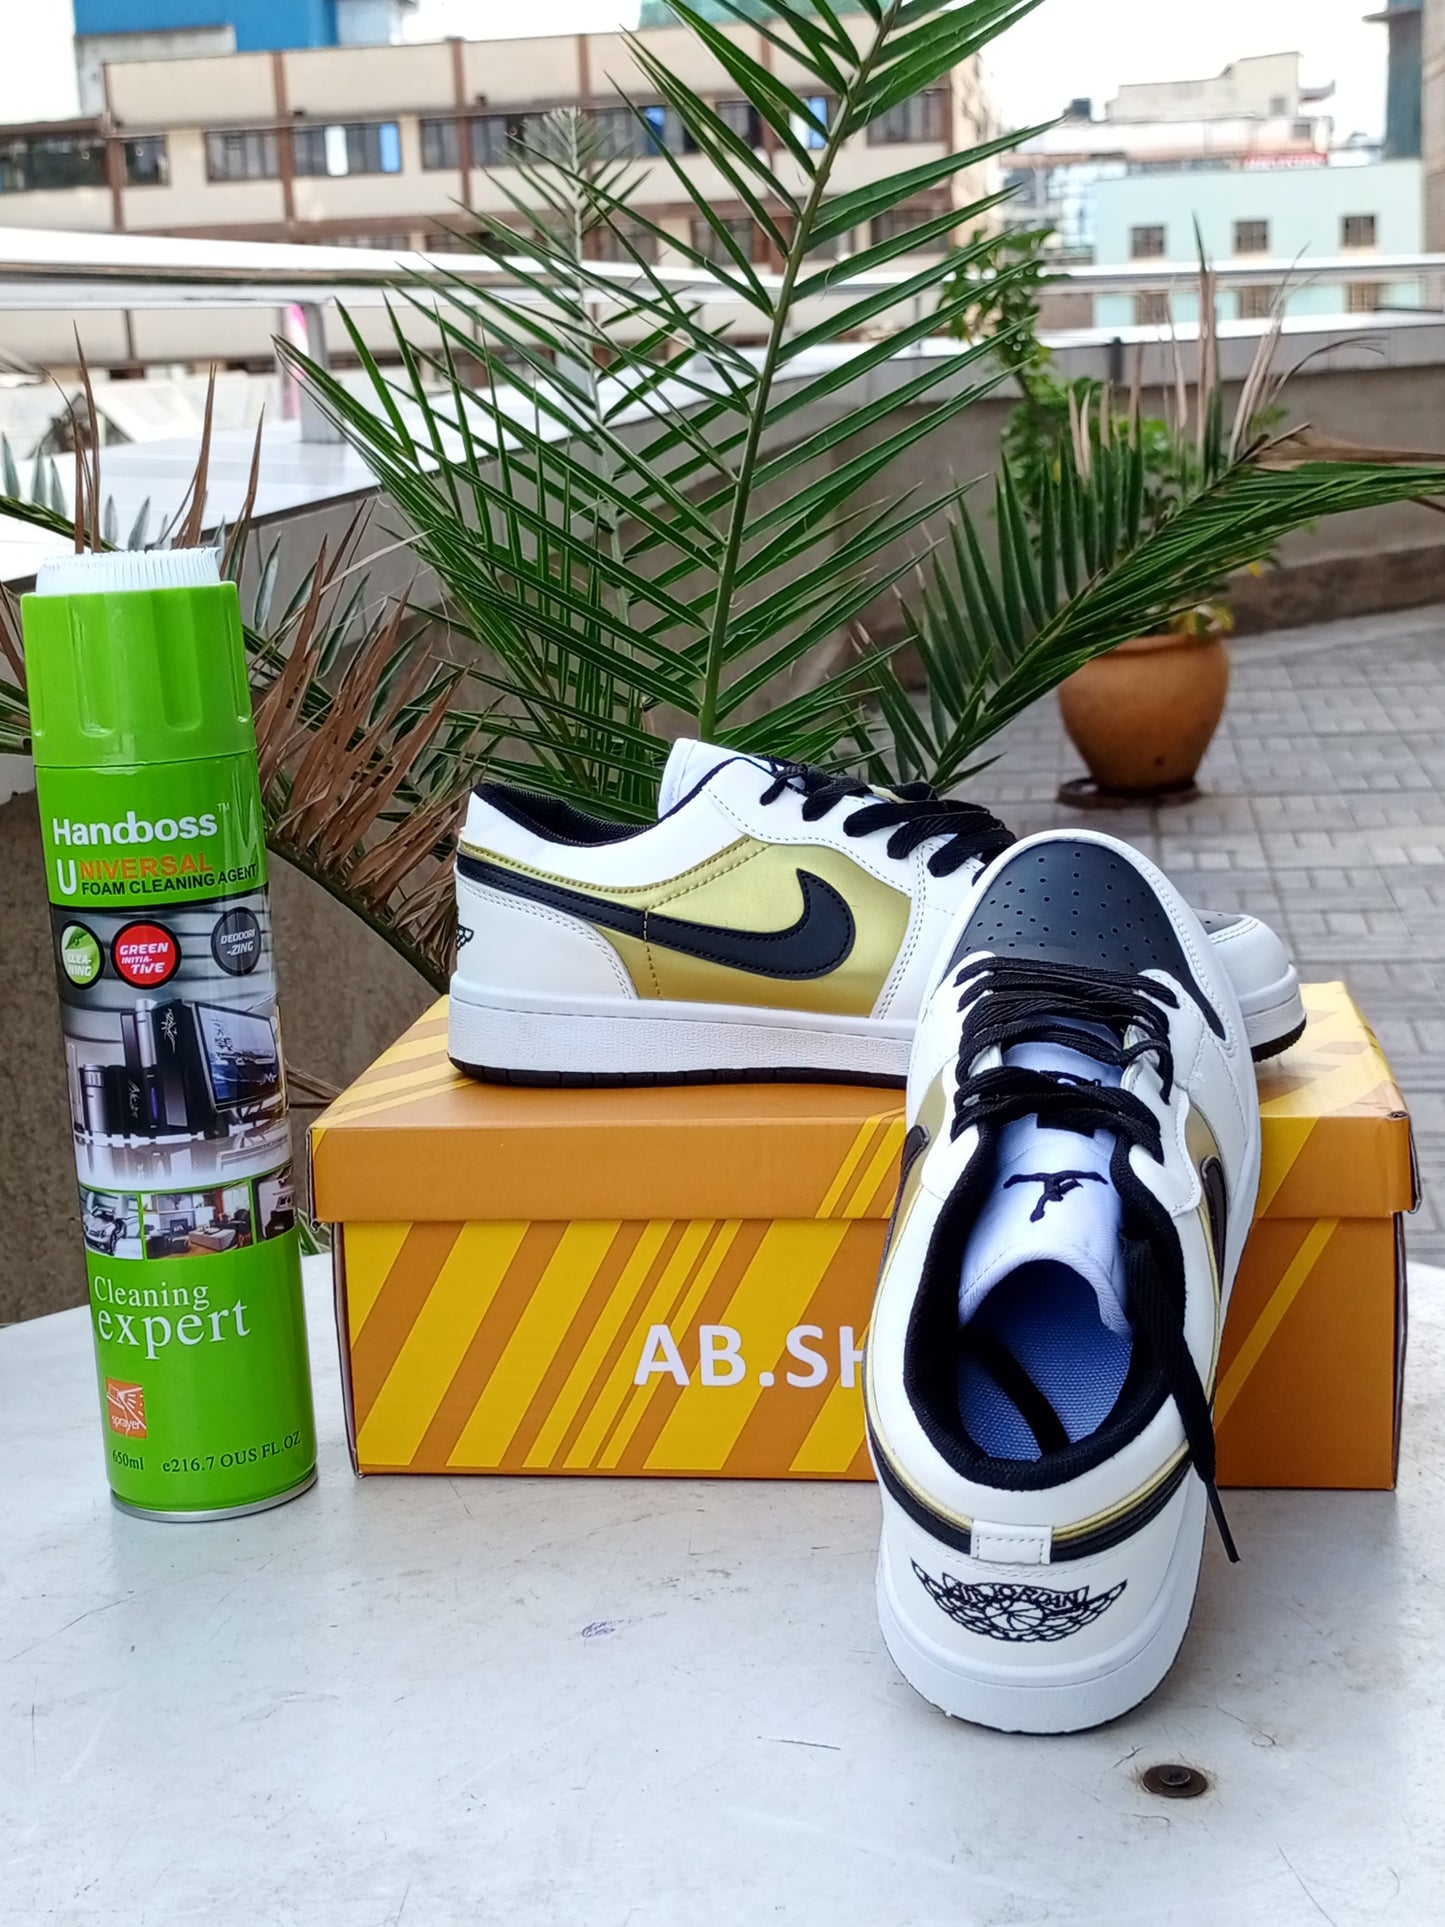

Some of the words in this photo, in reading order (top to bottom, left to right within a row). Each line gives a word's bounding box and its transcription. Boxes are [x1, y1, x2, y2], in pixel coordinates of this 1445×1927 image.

[52, 811, 218, 846] Handboss
[57, 852, 213, 896] UNIVERSAL
[82, 882, 125, 896] FOAM
[129, 873, 215, 894] CLEANING
[217, 864, 257, 885] AGENT
[119, 942, 169, 956] GREEN
[94, 1275, 210, 1311] Cleaning
[98, 1299, 251, 1360] expert
[112, 1450, 145, 1470] 650ml
[220, 1447, 258, 1468] OUS
[261, 1430, 301, 1459] FL.OZ
